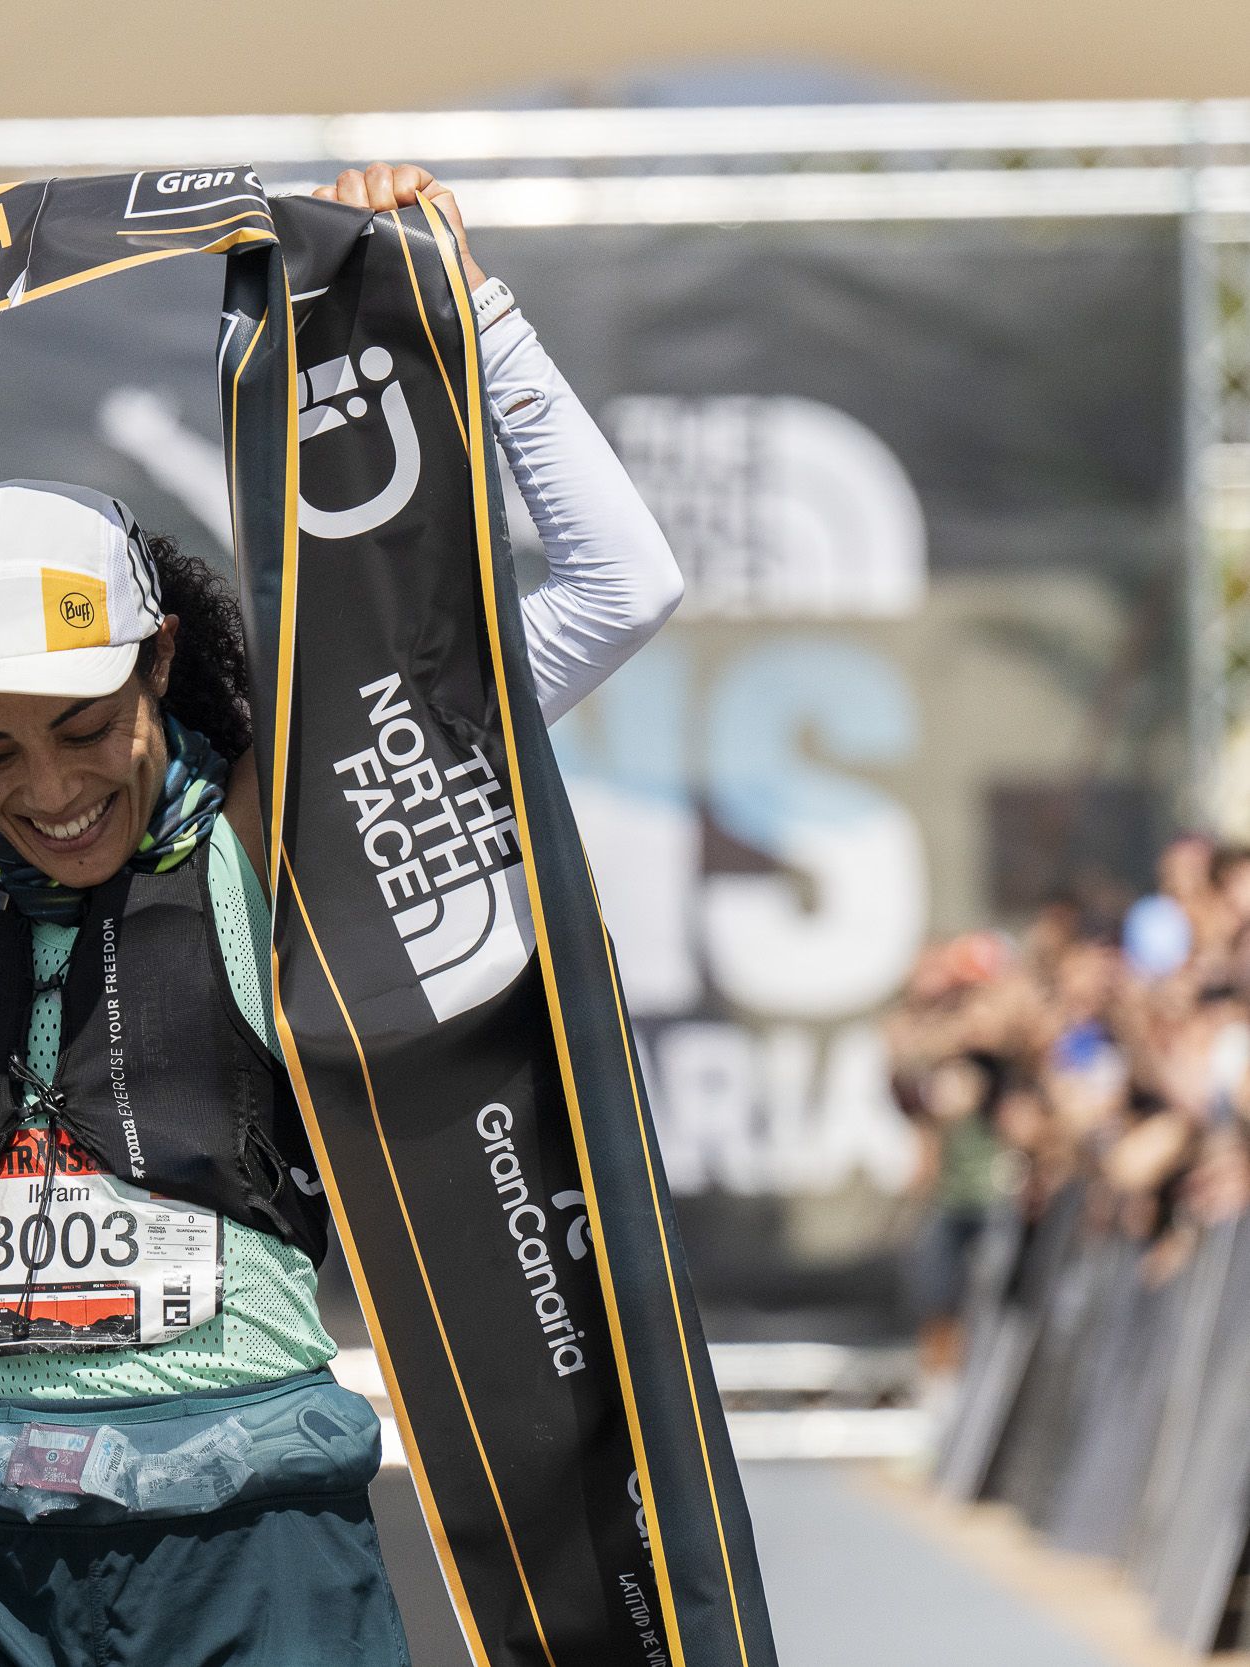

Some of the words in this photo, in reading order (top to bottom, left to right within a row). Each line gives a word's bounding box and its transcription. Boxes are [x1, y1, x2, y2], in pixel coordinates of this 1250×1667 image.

[156, 171, 235, 194] Gran
[63, 600, 91, 622] Buff
[358, 671, 480, 889] NORTH
[443, 743, 522, 868] THE
[332, 746, 432, 909] FACE
[102, 917, 118, 994] FREEDOM
[108, 999, 122, 1044] YOUR
[109, 1048, 133, 1117] EXERCISE
[476, 1102, 586, 1377] GranCanaria
[618, 1573, 650, 1627] LATITUD
[639, 1630, 660, 1649] DE
